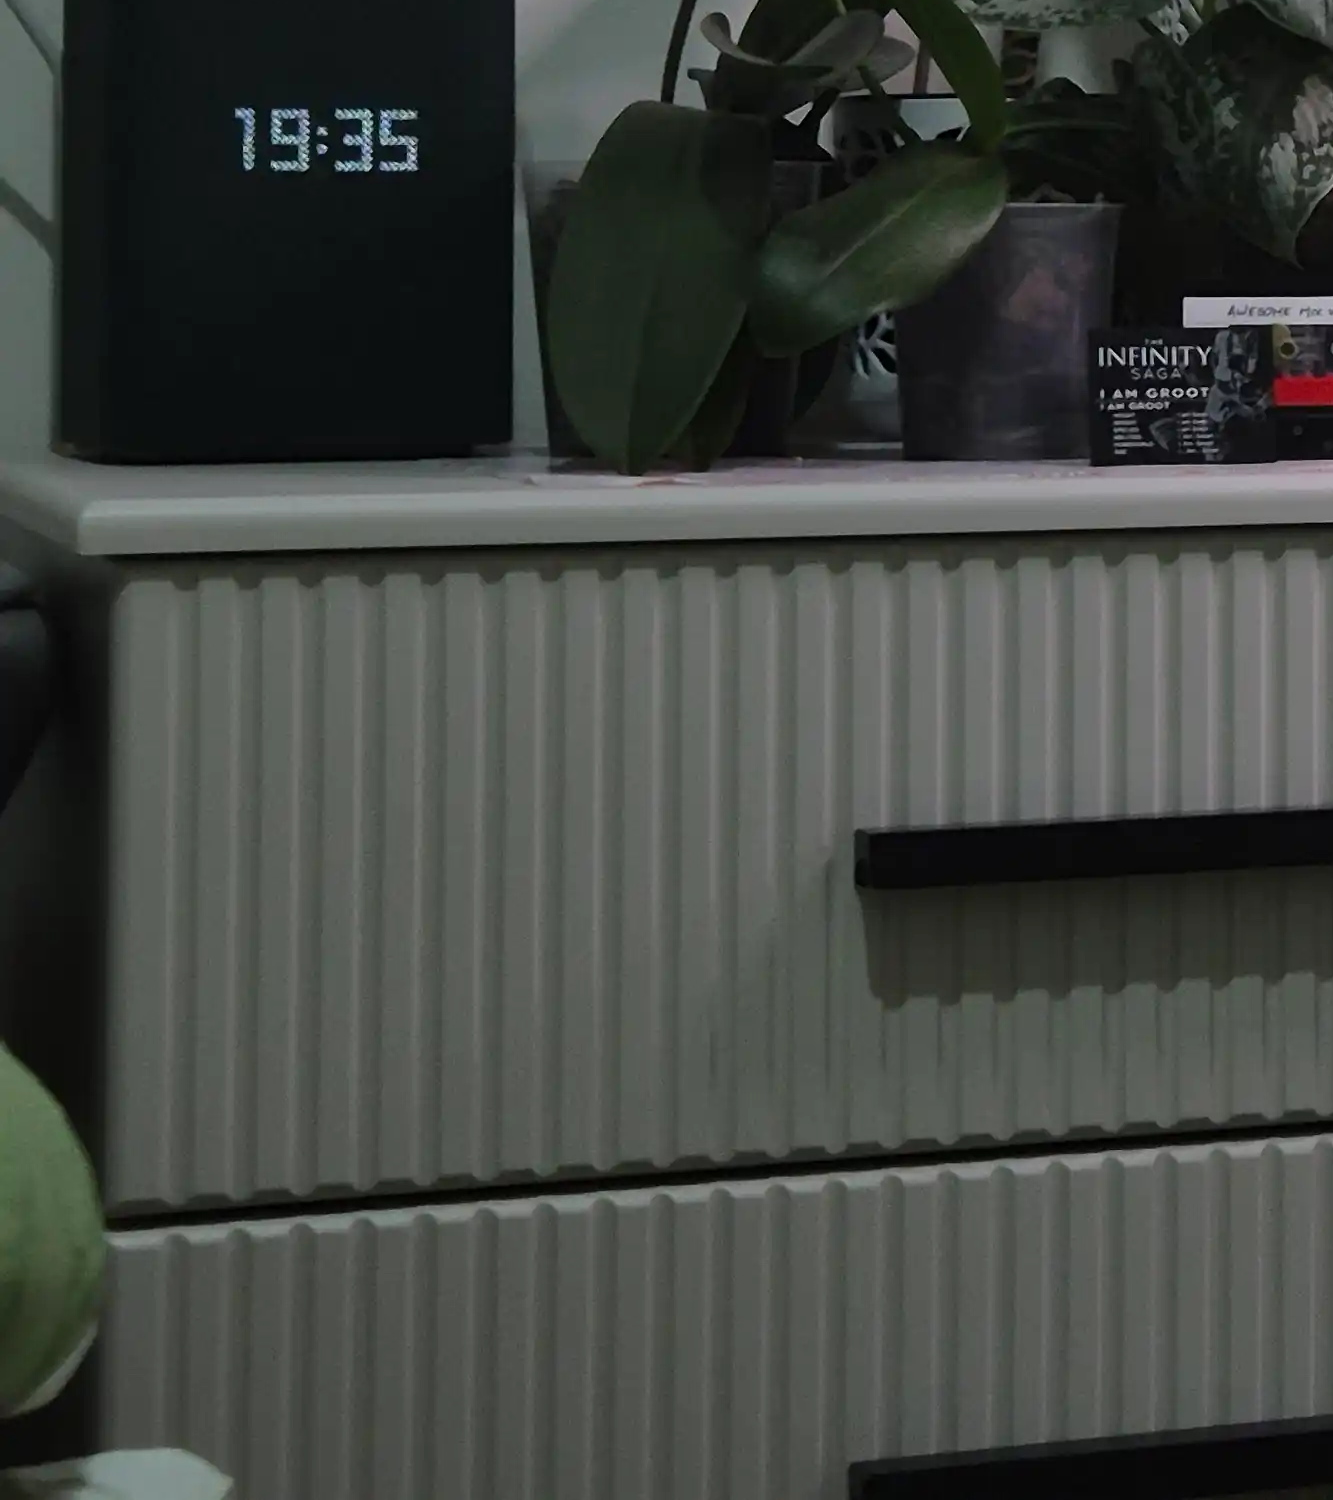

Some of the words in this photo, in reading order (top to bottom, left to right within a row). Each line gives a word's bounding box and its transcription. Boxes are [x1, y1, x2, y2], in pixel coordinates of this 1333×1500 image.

[234, 107, 420, 172] 19:35
[1227, 304, 1292, 317] AWESOME
[1098, 345, 1213, 368] INFINITY
[1130, 367, 1183, 381] SAGA
[1099, 388, 1106, 400] I
[1112, 388, 1139, 400] AM
[1145, 386, 1210, 400] GROOT
